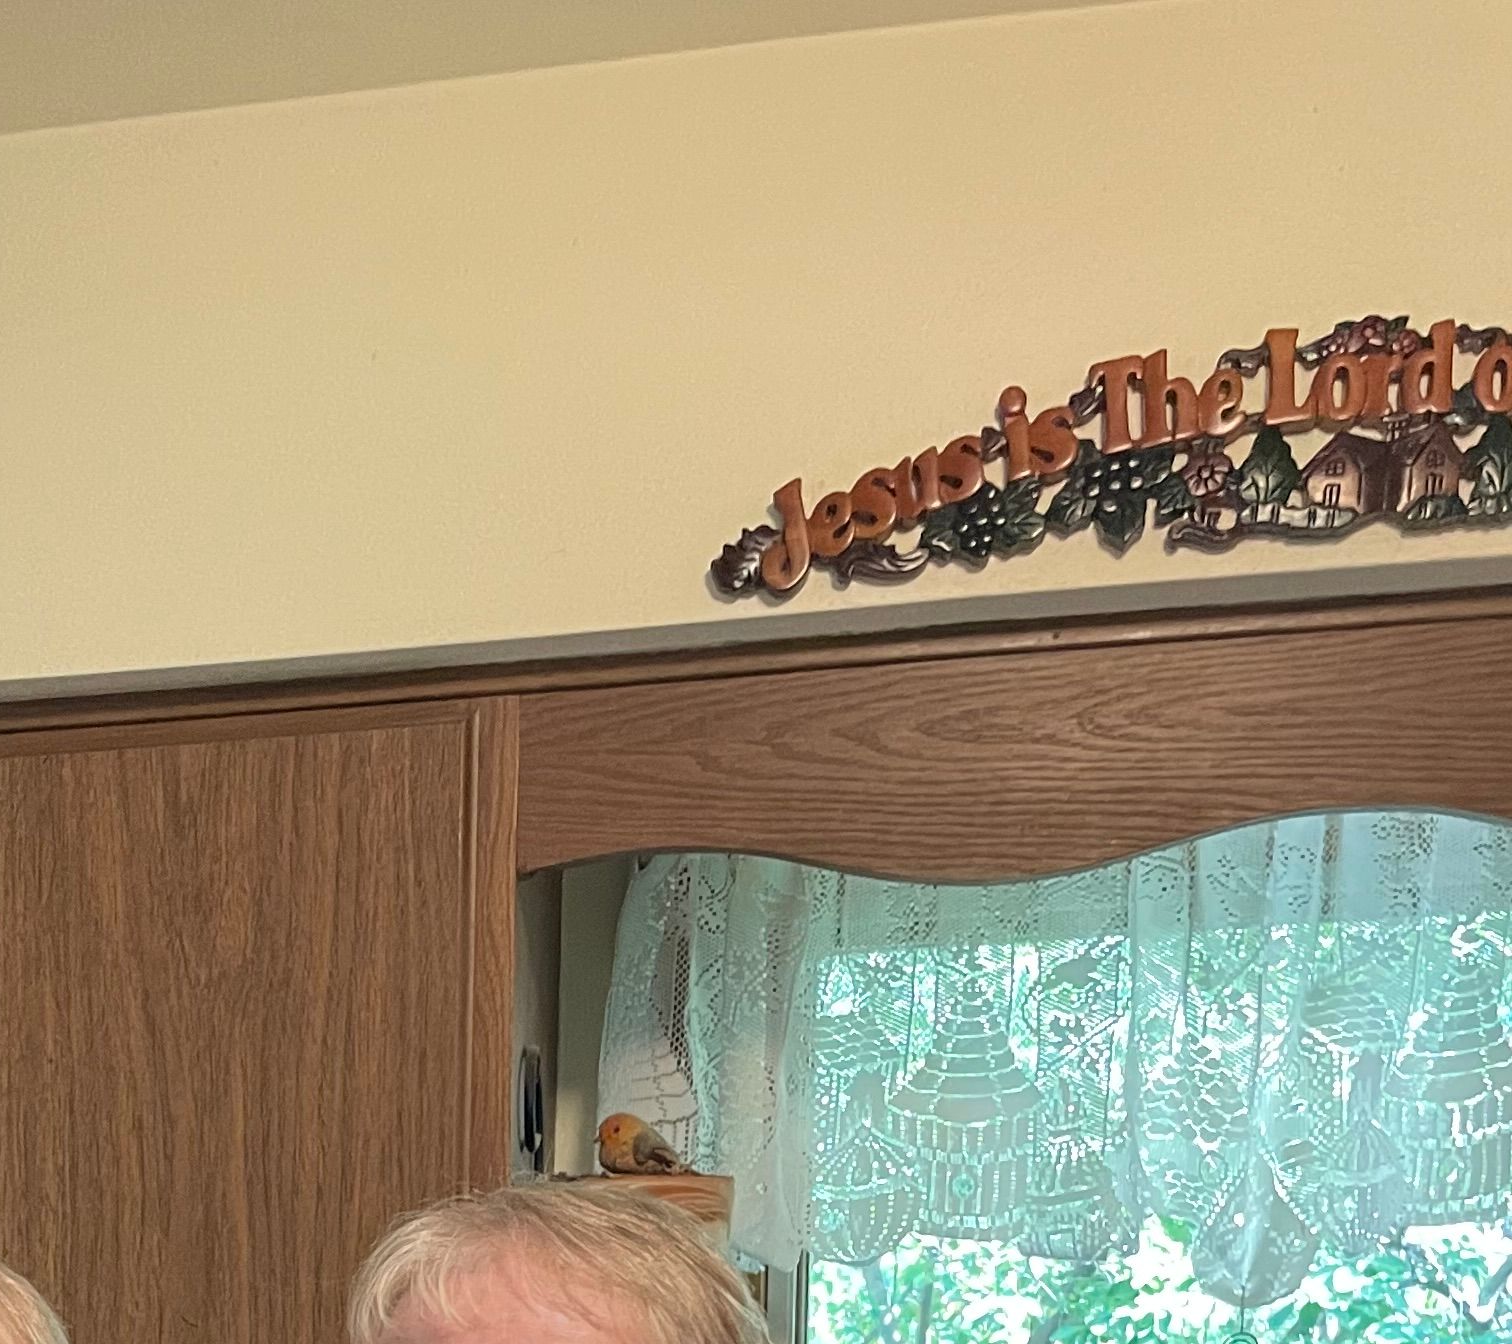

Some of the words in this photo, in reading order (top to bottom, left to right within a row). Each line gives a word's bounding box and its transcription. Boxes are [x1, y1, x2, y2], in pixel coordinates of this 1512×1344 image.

[760, 436, 986, 591] Jesus
[998, 385, 1080, 481] is
[1087, 348, 1245, 455] The
[1264, 318, 1456, 426] Lord
